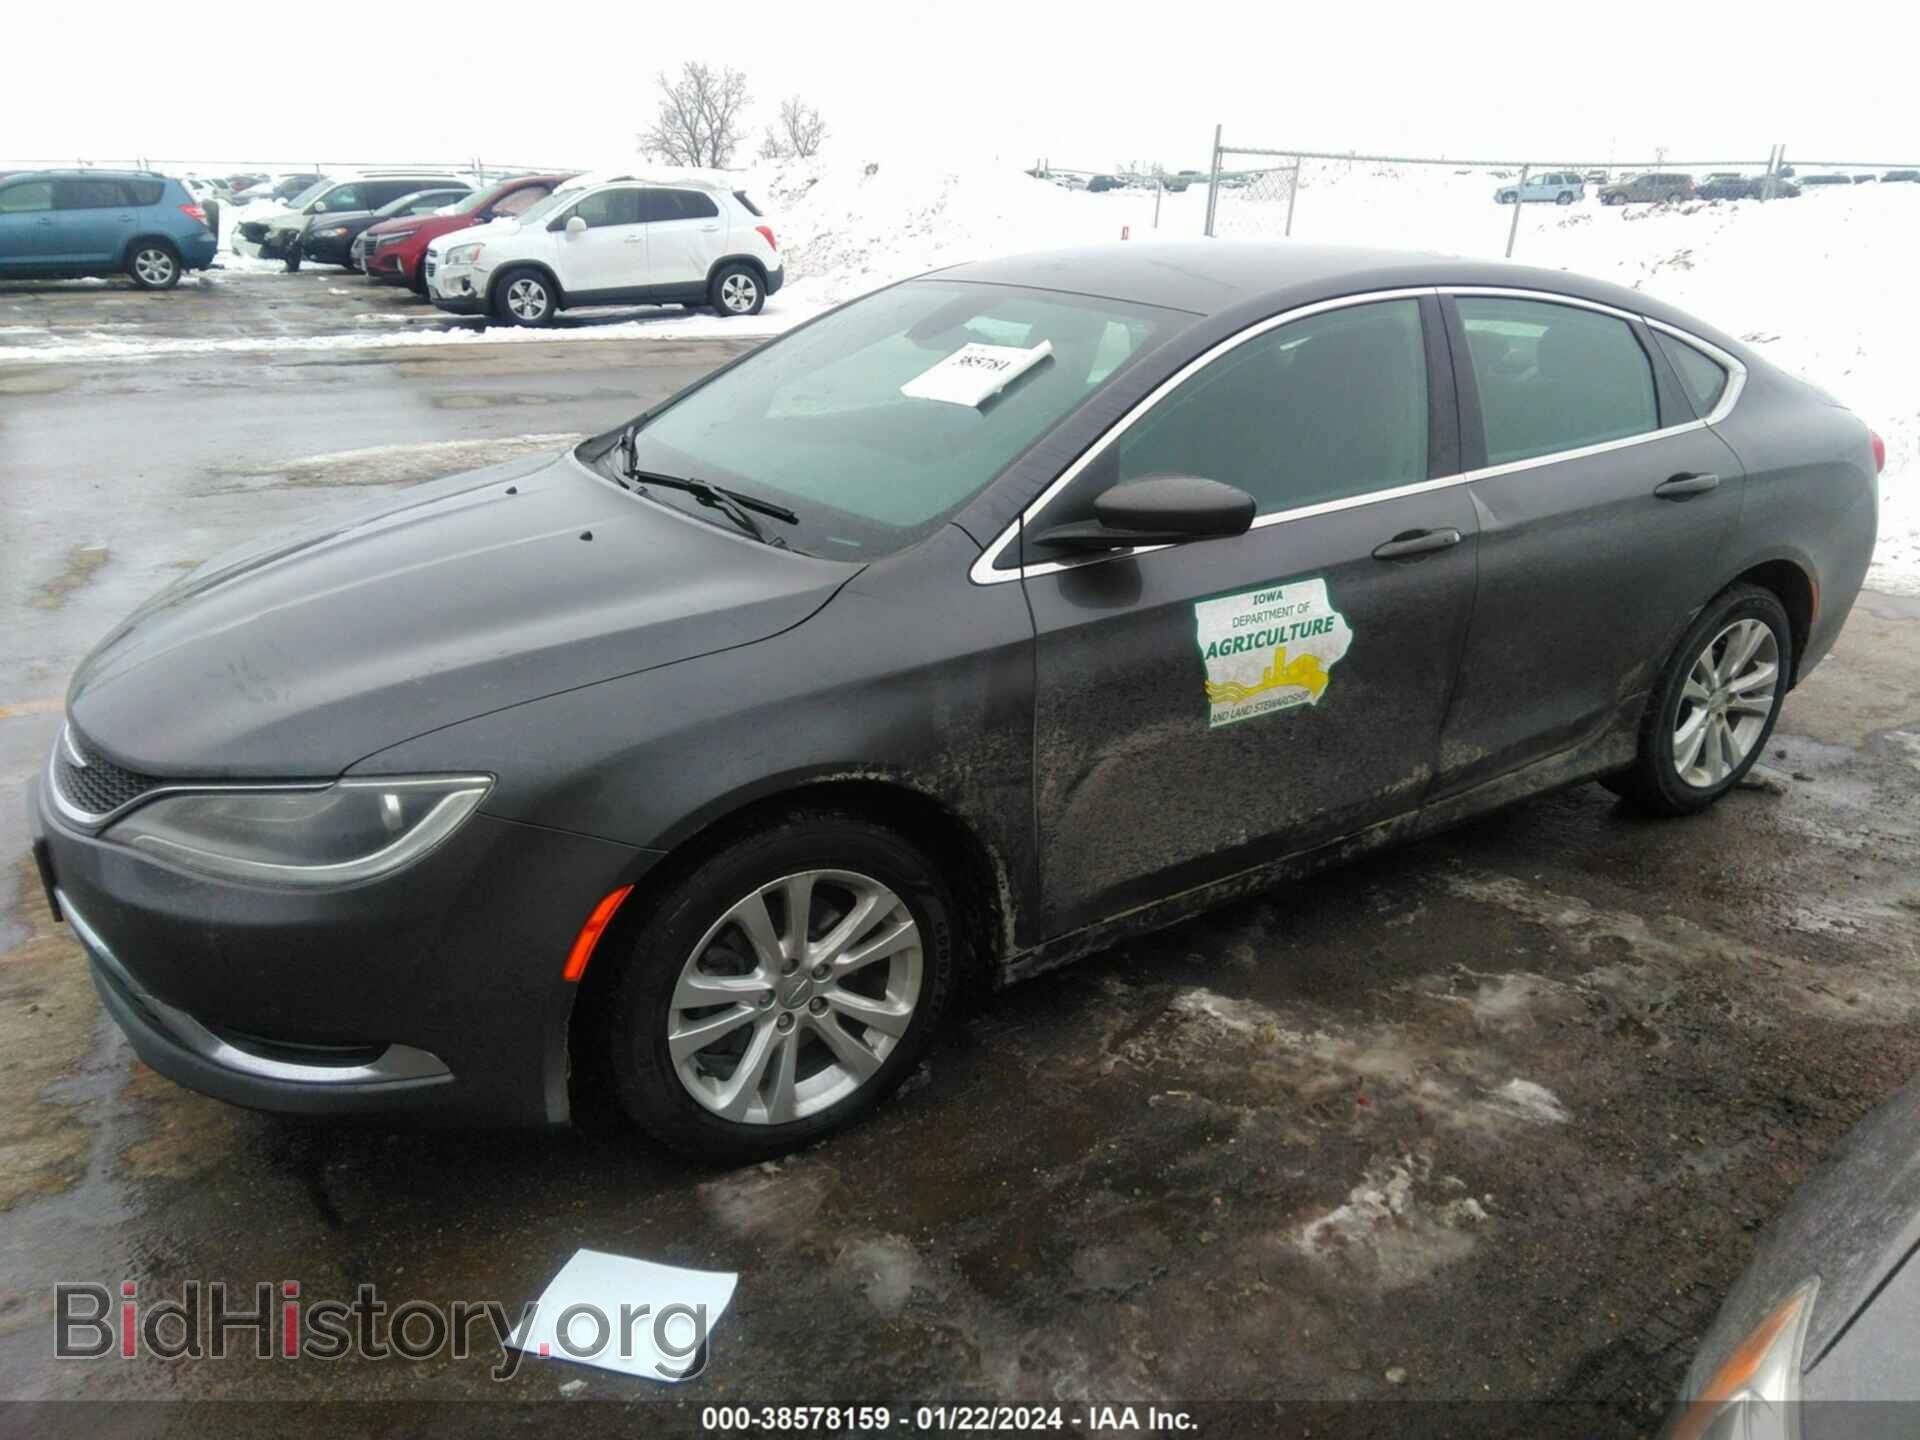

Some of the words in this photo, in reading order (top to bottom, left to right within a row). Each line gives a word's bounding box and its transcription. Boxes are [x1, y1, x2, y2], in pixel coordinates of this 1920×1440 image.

[1253, 591, 1283, 605] IOWA
[1232, 607, 1294, 628] DEPARTMENT
[1297, 602, 1311, 614] OF
[1206, 616, 1335, 660] AGRICULTURE
[1231, 703, 1253, 718] LAND
